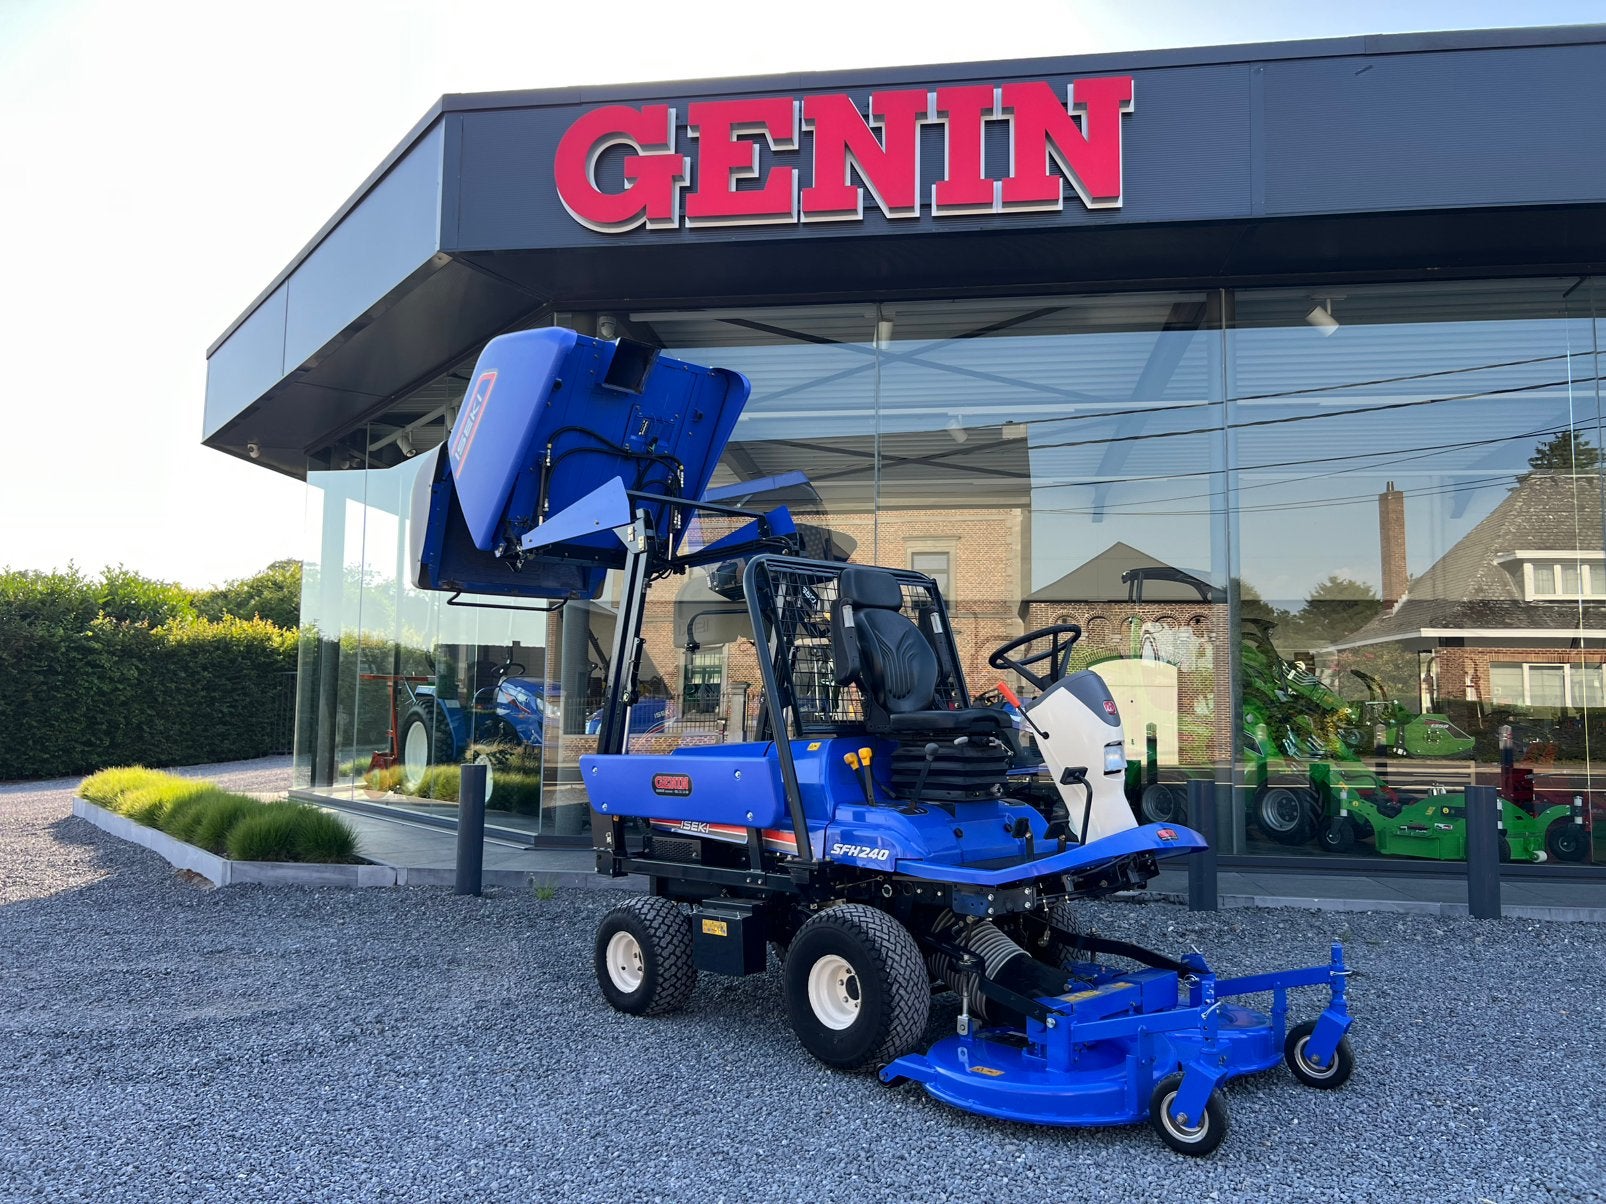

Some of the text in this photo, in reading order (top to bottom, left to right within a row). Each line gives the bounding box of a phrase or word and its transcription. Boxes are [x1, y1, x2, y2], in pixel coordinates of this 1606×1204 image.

[554, 76, 1135, 234] GENIN
[454, 393, 482, 461] ISEKI
[655, 775, 689, 790] GENIN
[680, 820, 710, 834] ISEKI
[830, 843, 890, 861] SFH240
